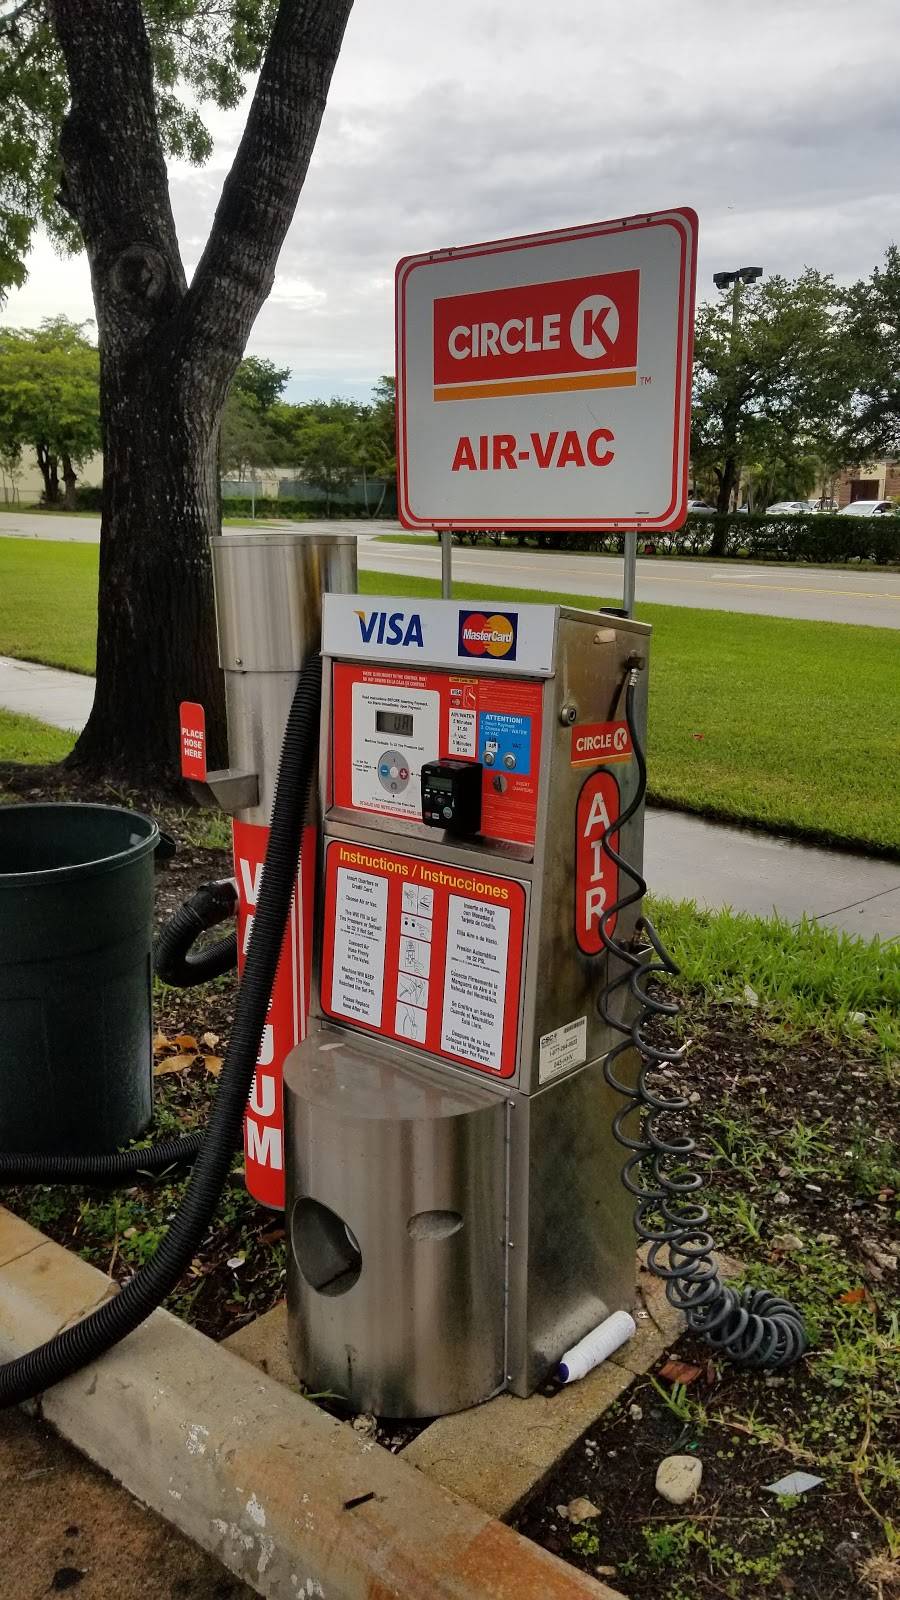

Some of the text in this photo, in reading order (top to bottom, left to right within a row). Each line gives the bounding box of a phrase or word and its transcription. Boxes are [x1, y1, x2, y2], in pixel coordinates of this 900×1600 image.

[448, 295, 619, 360] CIRCLE K
[451, 428, 615, 472] AIR-VAC
[353, 611, 424, 647] VISA
[463, 628, 513, 643] MasterCard
[486, 714, 523, 724] ATTENTION!
[181, 728, 204, 739] PLACE
[576, 728, 627, 751] CIRCLE K
[184, 738, 202, 749] HOSE
[184, 748, 202, 759] HERE
[584, 792, 611, 931] AIR
[340, 848, 509, 900] Instructions / Instrucciones
[472, 912, 490, 922] Monedas
[484, 908, 495, 916] Pago
[461, 916, 474, 925] Tarjeta
[342, 966, 356, 975] Machine
[451, 978, 472, 989] Manguera
[343, 995, 370, 1009] Please Replace
[450, 1007, 465, 1017] Cuando
[456, 1046, 469, 1056] Lugar
[478, 1054, 490, 1063] Favor.
[468, 1043, 489, 1056] Manguera
